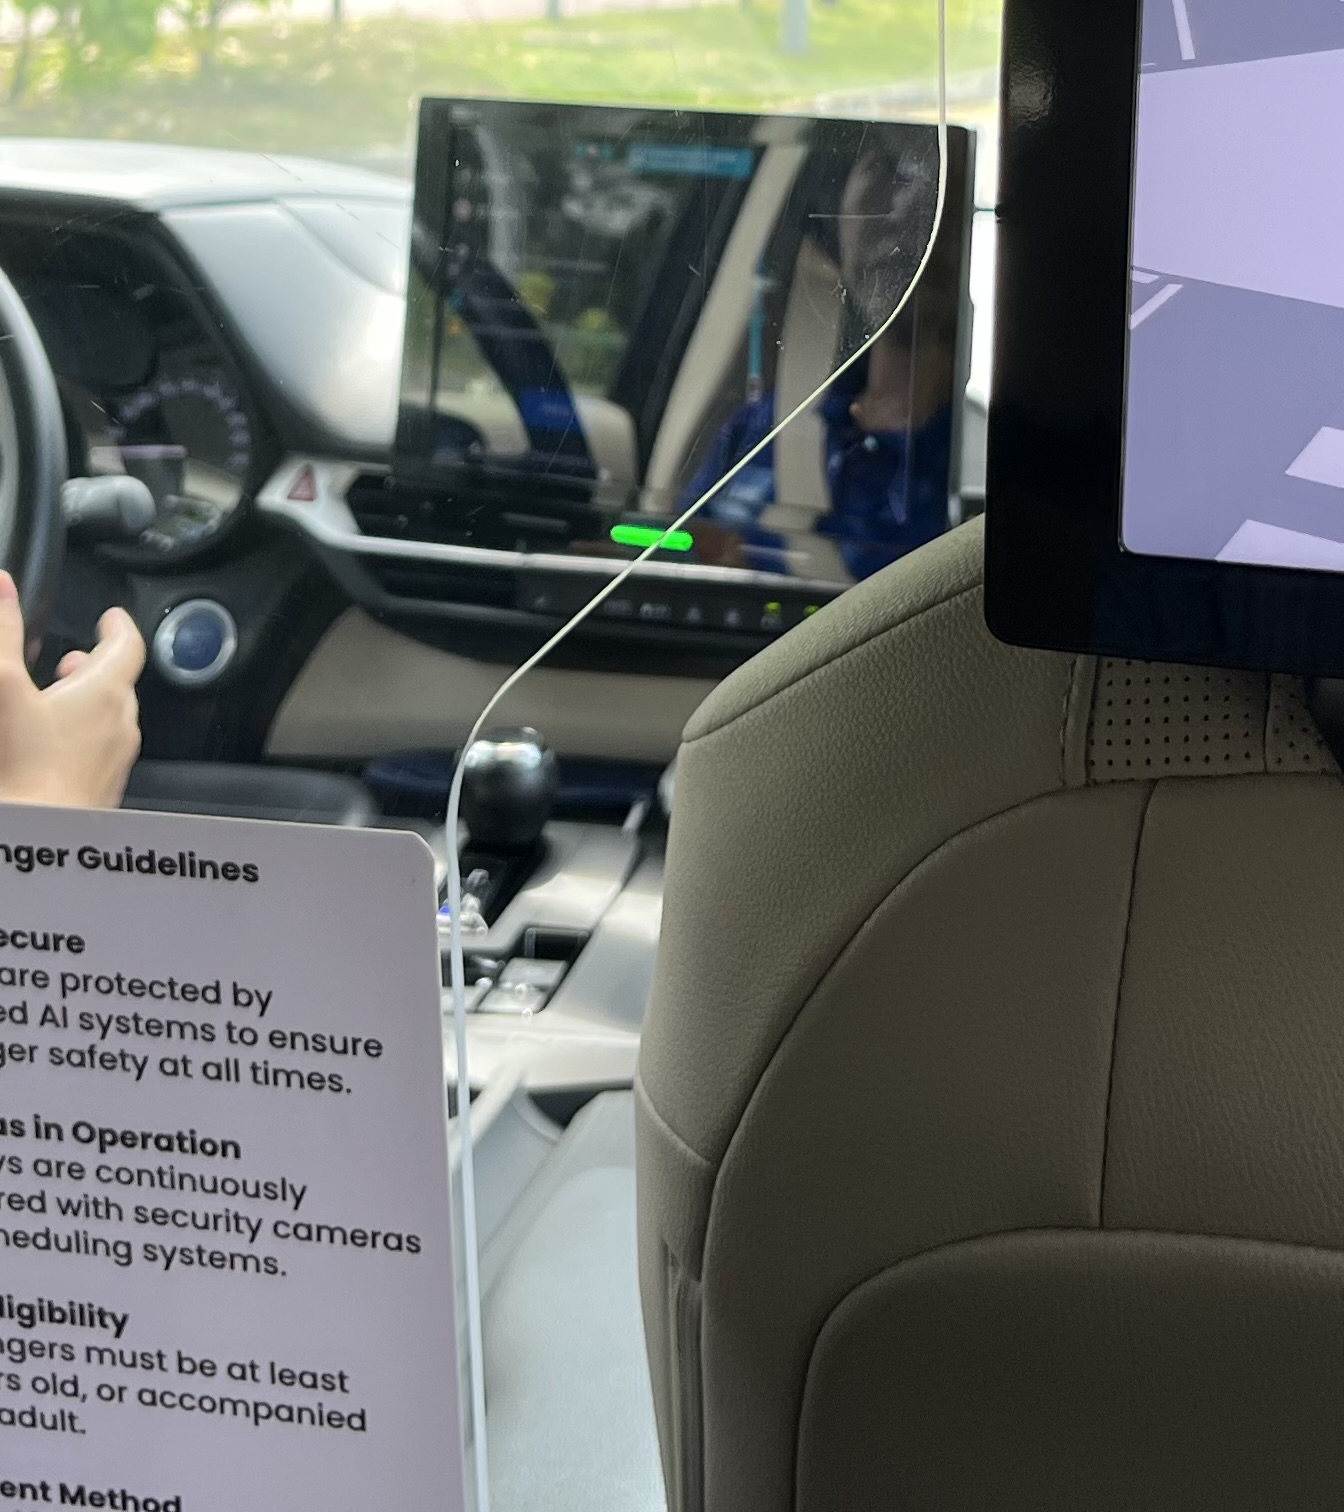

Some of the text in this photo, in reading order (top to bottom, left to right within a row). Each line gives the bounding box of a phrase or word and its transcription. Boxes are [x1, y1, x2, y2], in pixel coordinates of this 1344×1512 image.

[76, 845, 259, 883] Guidelines
[60, 972, 222, 1005] protected
[232, 981, 273, 1018] by
[39, 1004, 69, 1029] AI
[78, 1011, 217, 1043] systems
[225, 1021, 259, 1047] to
[268, 1029, 383, 1059] ensure
[48, 1043, 149, 1082] safety
[158, 1054, 193, 1079] at
[201, 1057, 241, 1084] all
[249, 1060, 352, 1094] times.
[33, 1113, 64, 1142] in
[71, 1120, 241, 1160] Operation
[32, 1158, 86, 1181] are
[95, 1164, 307, 1211] continuously
[56, 1193, 124, 1222] with
[134, 1205, 263, 1244] security
[272, 1220, 422, 1254] cameras
[142, 1243, 287, 1277] systems.
[85, 1345, 167, 1372] must
[176, 1350, 217, 1378] be
[226, 1359, 260, 1383] at
[269, 1361, 350, 1394] least
[30, 1372, 87, 1403] old,
[96, 1383, 128, 1403] or
[137, 1388, 367, 1432] accompanied
[58, 1482, 182, 1512] Method
